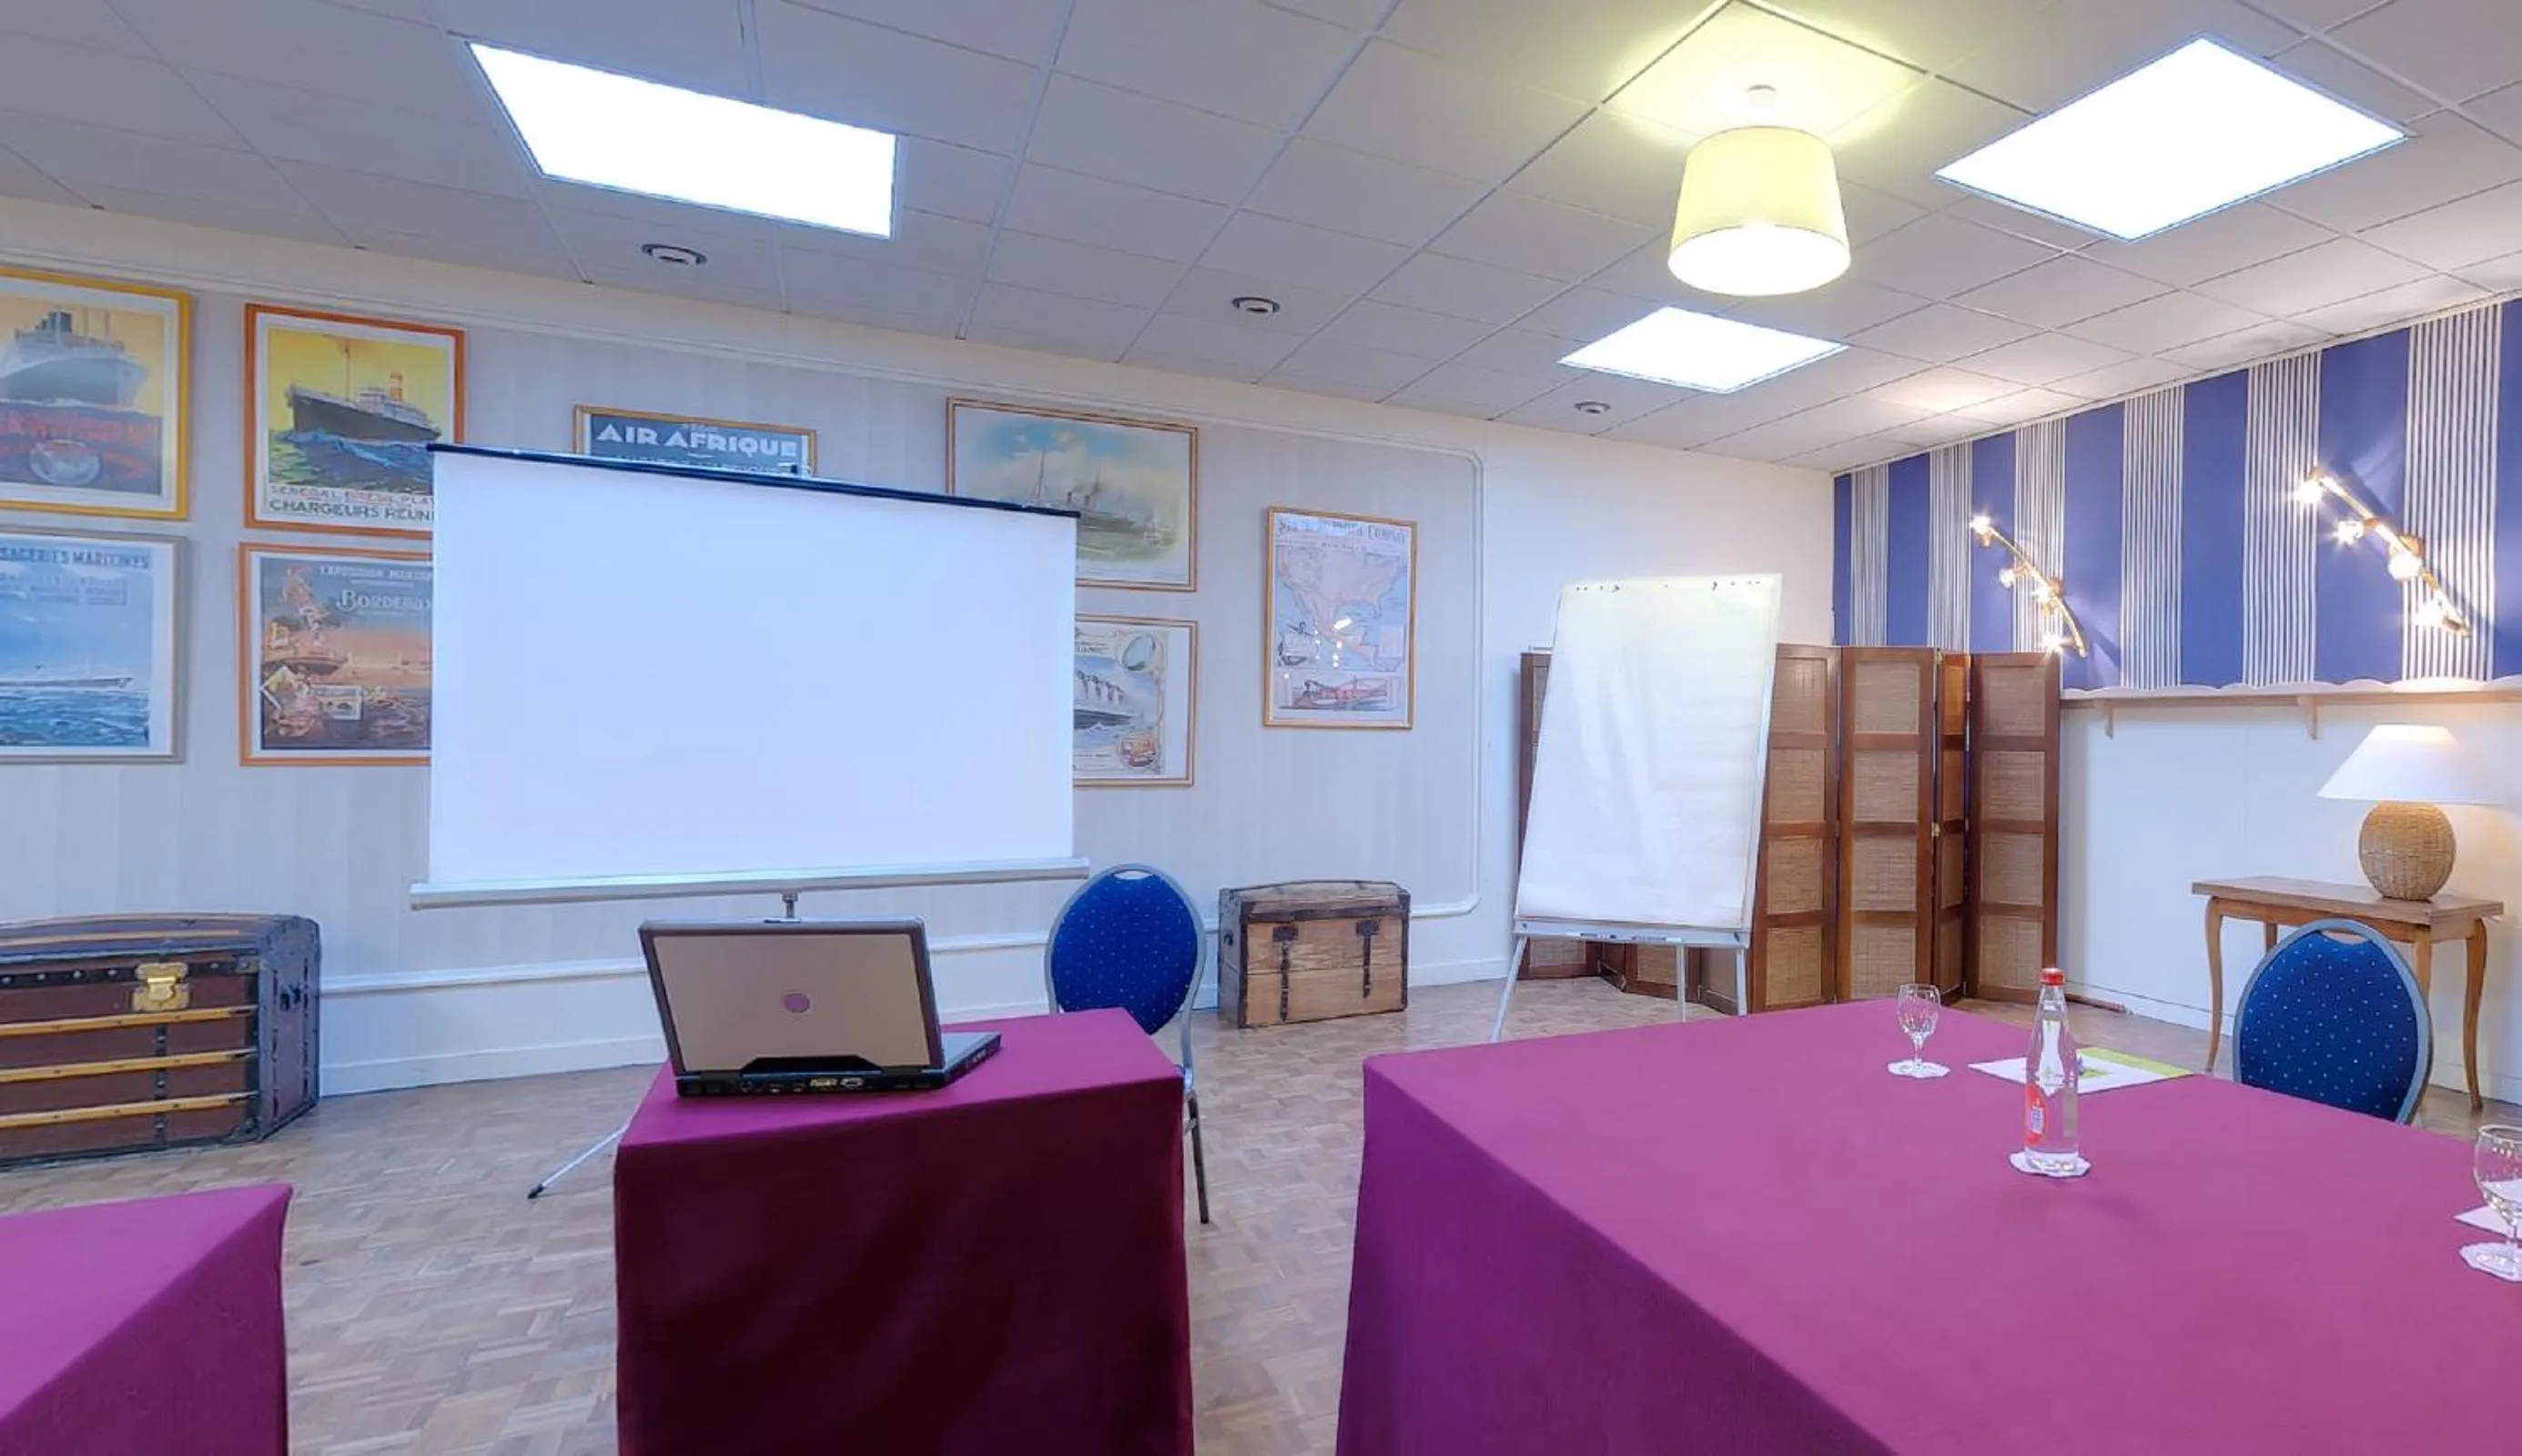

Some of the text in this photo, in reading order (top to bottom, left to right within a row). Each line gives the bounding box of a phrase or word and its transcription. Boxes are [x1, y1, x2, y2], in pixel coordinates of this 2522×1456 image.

[596, 422, 798, 458] AIR AFRIQUE
[269, 500, 380, 520] CHARGEURS
